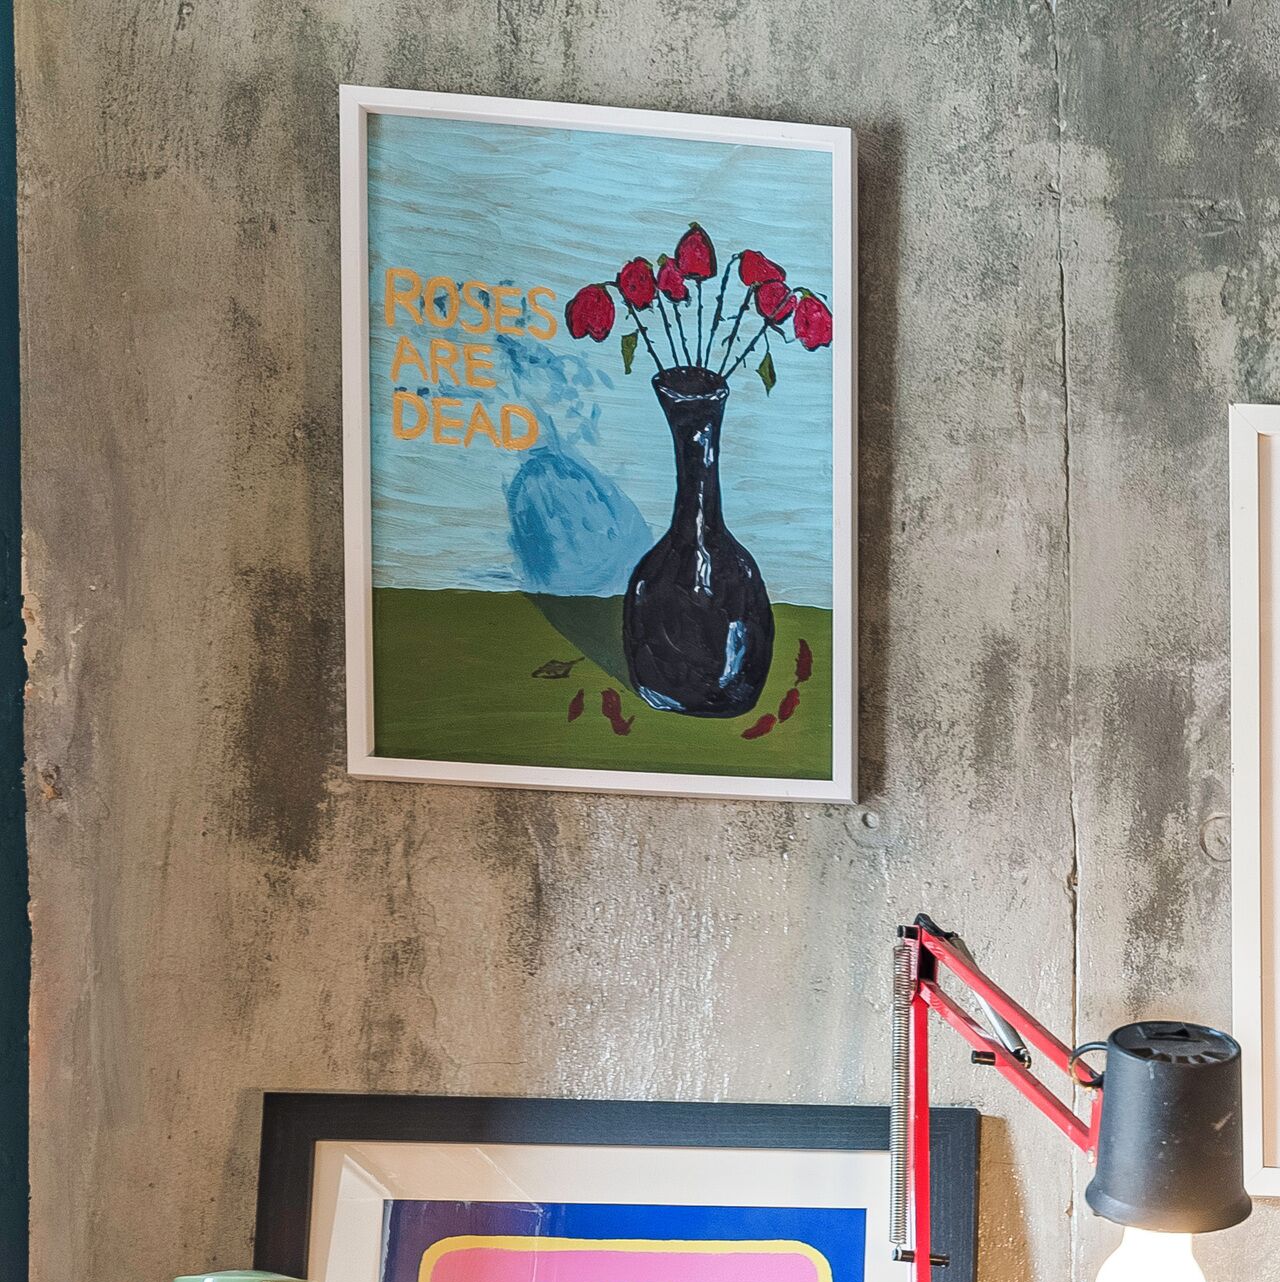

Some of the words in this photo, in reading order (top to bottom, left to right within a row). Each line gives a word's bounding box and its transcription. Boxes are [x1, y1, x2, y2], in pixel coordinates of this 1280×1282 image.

[383, 267, 559, 341] ROSES
[390, 337, 497, 391] ARE
[391, 390, 540, 451] DEAD
